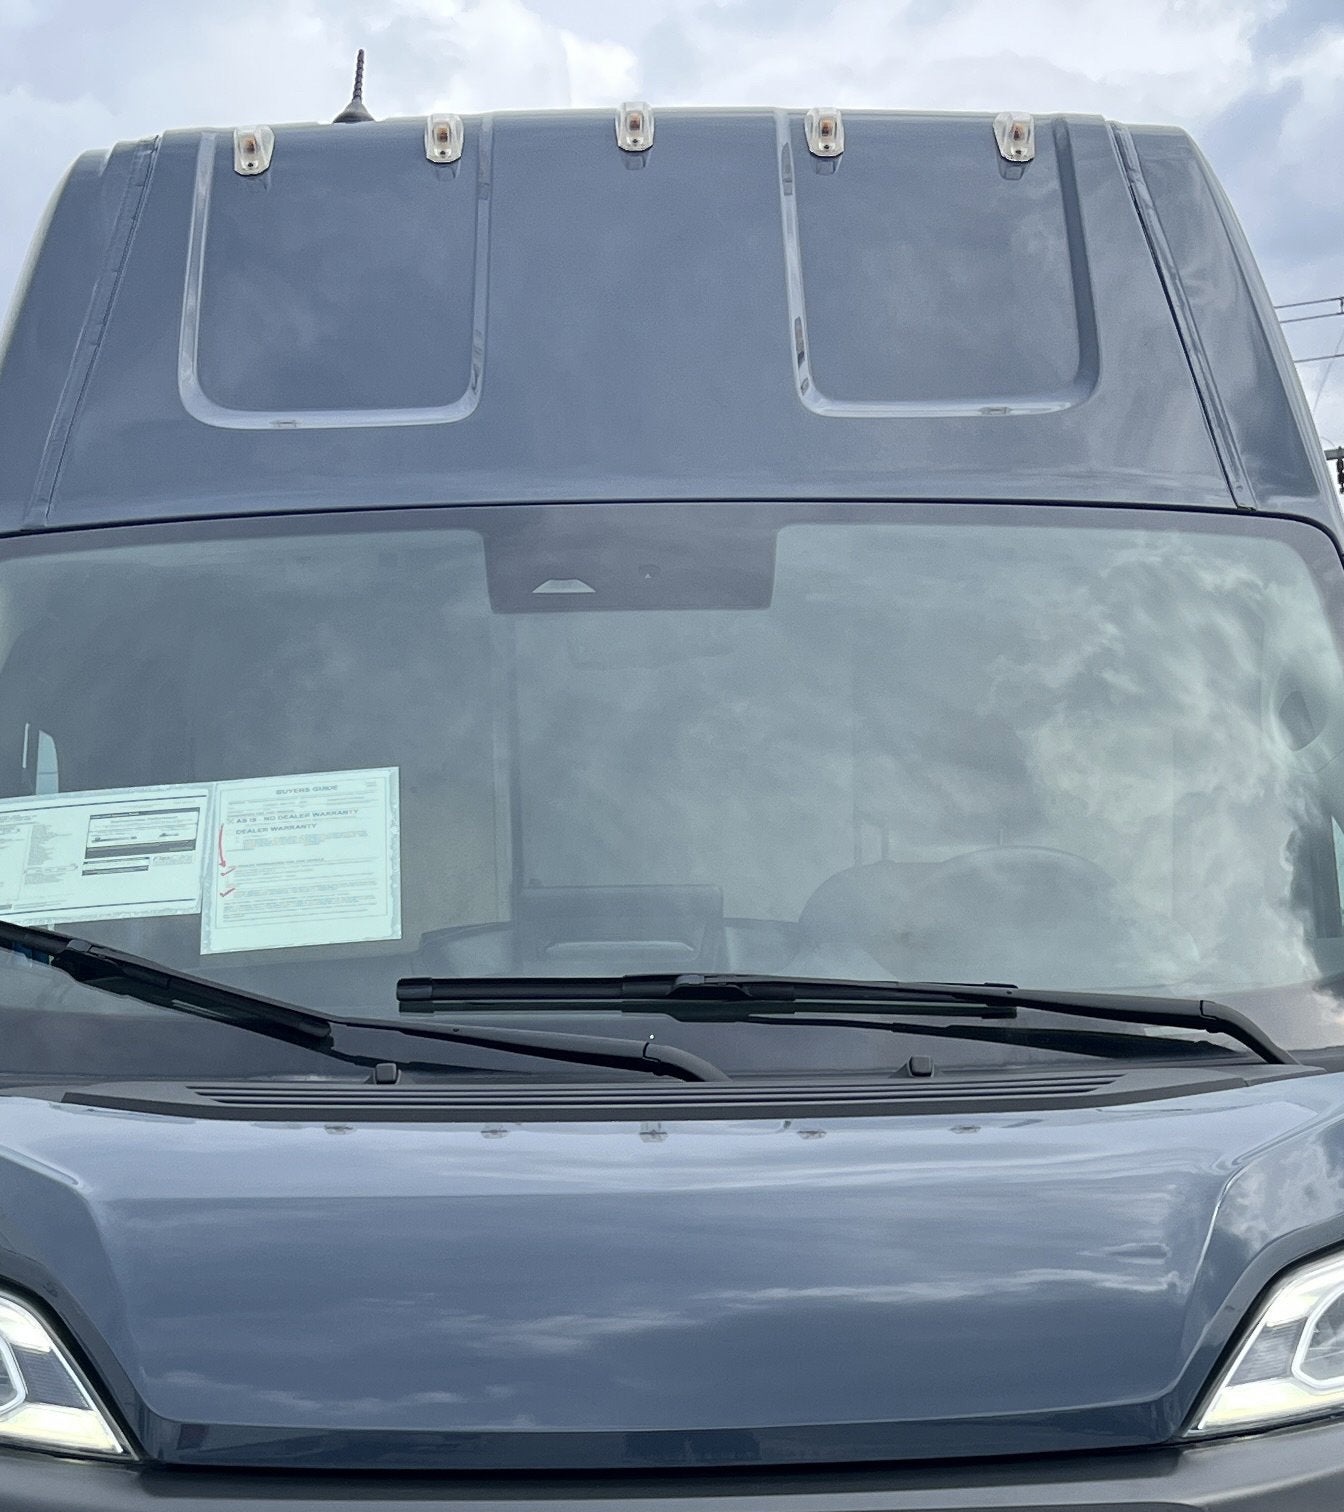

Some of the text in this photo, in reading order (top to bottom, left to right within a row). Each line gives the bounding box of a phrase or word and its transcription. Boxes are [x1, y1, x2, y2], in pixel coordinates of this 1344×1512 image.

[275, 787, 310, 796] BUYERS
[277, 812, 311, 820] DEALER
[312, 809, 359, 818] WARRANTY
[235, 823, 317, 835] DEALER WARRANTY
